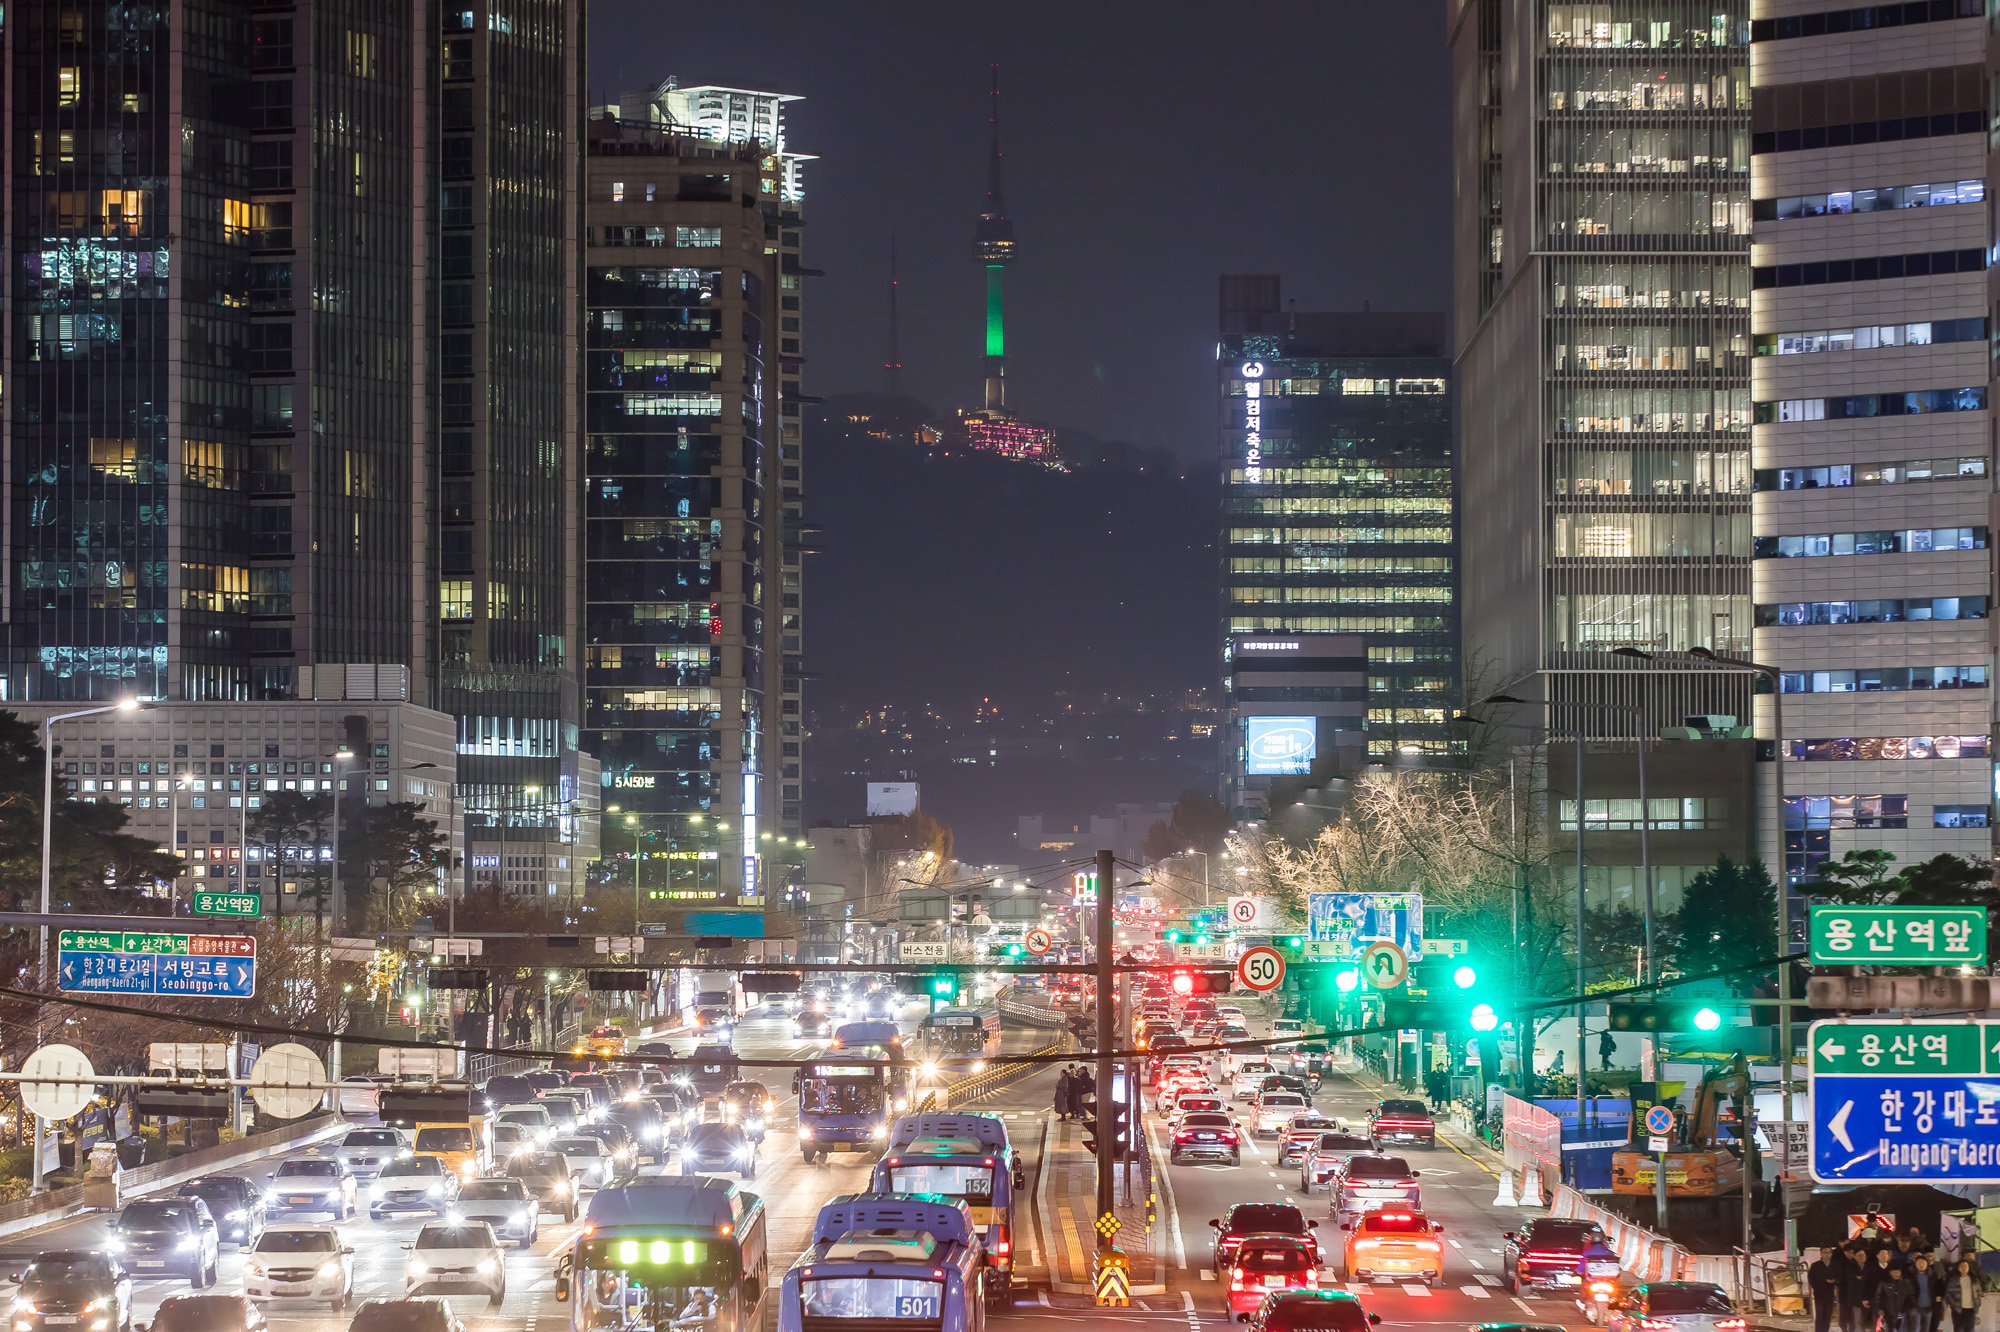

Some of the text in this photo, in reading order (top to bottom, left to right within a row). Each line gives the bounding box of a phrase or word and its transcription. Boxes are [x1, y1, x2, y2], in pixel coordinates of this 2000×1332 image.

[1245, 382, 1261, 484] 웰컴저축은행
[615, 776, 656, 788] 5시50분
[200, 896, 255, 913] 용산역앞
[75, 936, 110, 949] 용산역
[1825, 919, 1973, 952] 용산역앞
[140, 938, 187, 952] 삼각지역
[192, 939, 237, 953] 국립중앙박물관
[903, 945, 945, 956] 버스전용
[83, 957, 150, 977] 한강대로21길
[164, 960, 229, 978] 서빙고로
[1250, 958, 1275, 980] 50
[131, 977, 150, 991] 21-gil
[162, 977, 229, 993] Seobinggo-ro
[1857, 1034, 1948, 1067] 용산역
[1880, 1088, 1999, 1134] 한강대로
[966, 1179, 989, 1193] 152
[901, 1298, 931, 1316] 501
